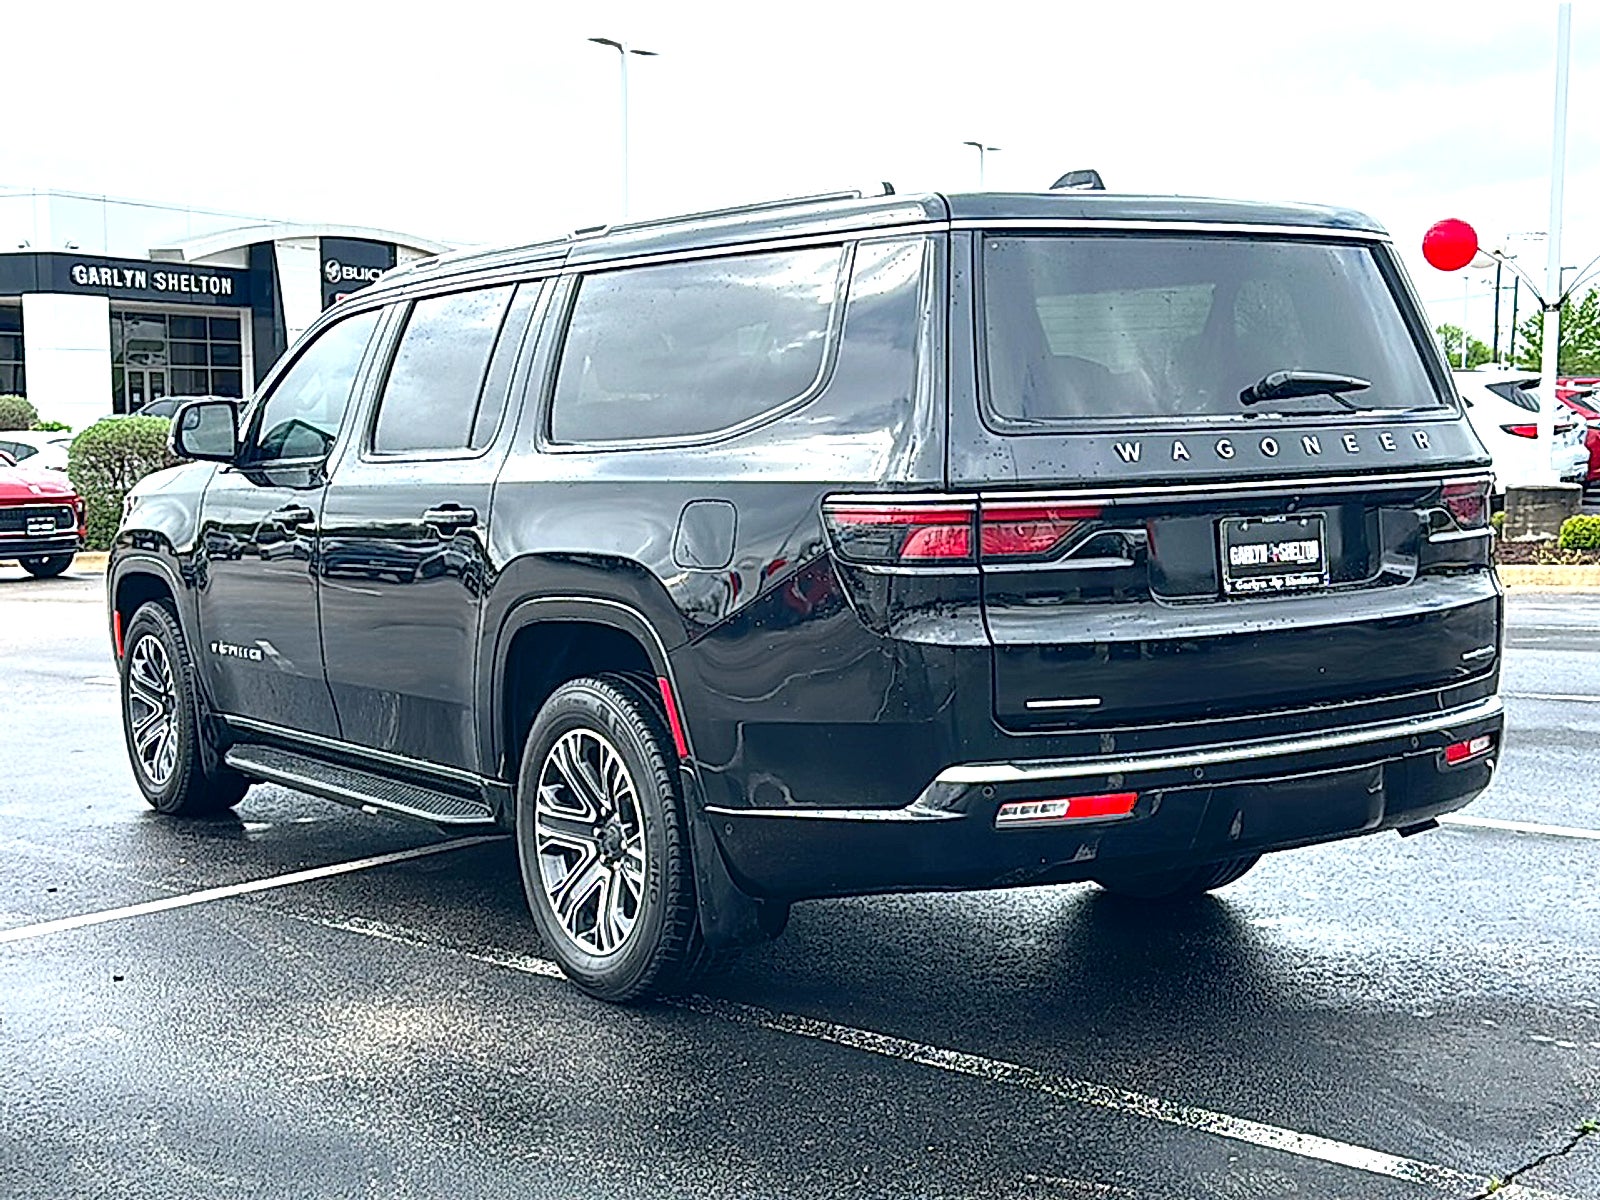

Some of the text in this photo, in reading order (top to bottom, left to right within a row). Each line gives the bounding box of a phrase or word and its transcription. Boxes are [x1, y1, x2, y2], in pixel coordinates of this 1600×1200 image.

[72, 264, 232, 295] GARLYN SHELTON
[342, 266, 384, 282] BUIC
[1114, 430, 1432, 463] WAGONEER
[1278, 540, 1320, 562] SHELTON
